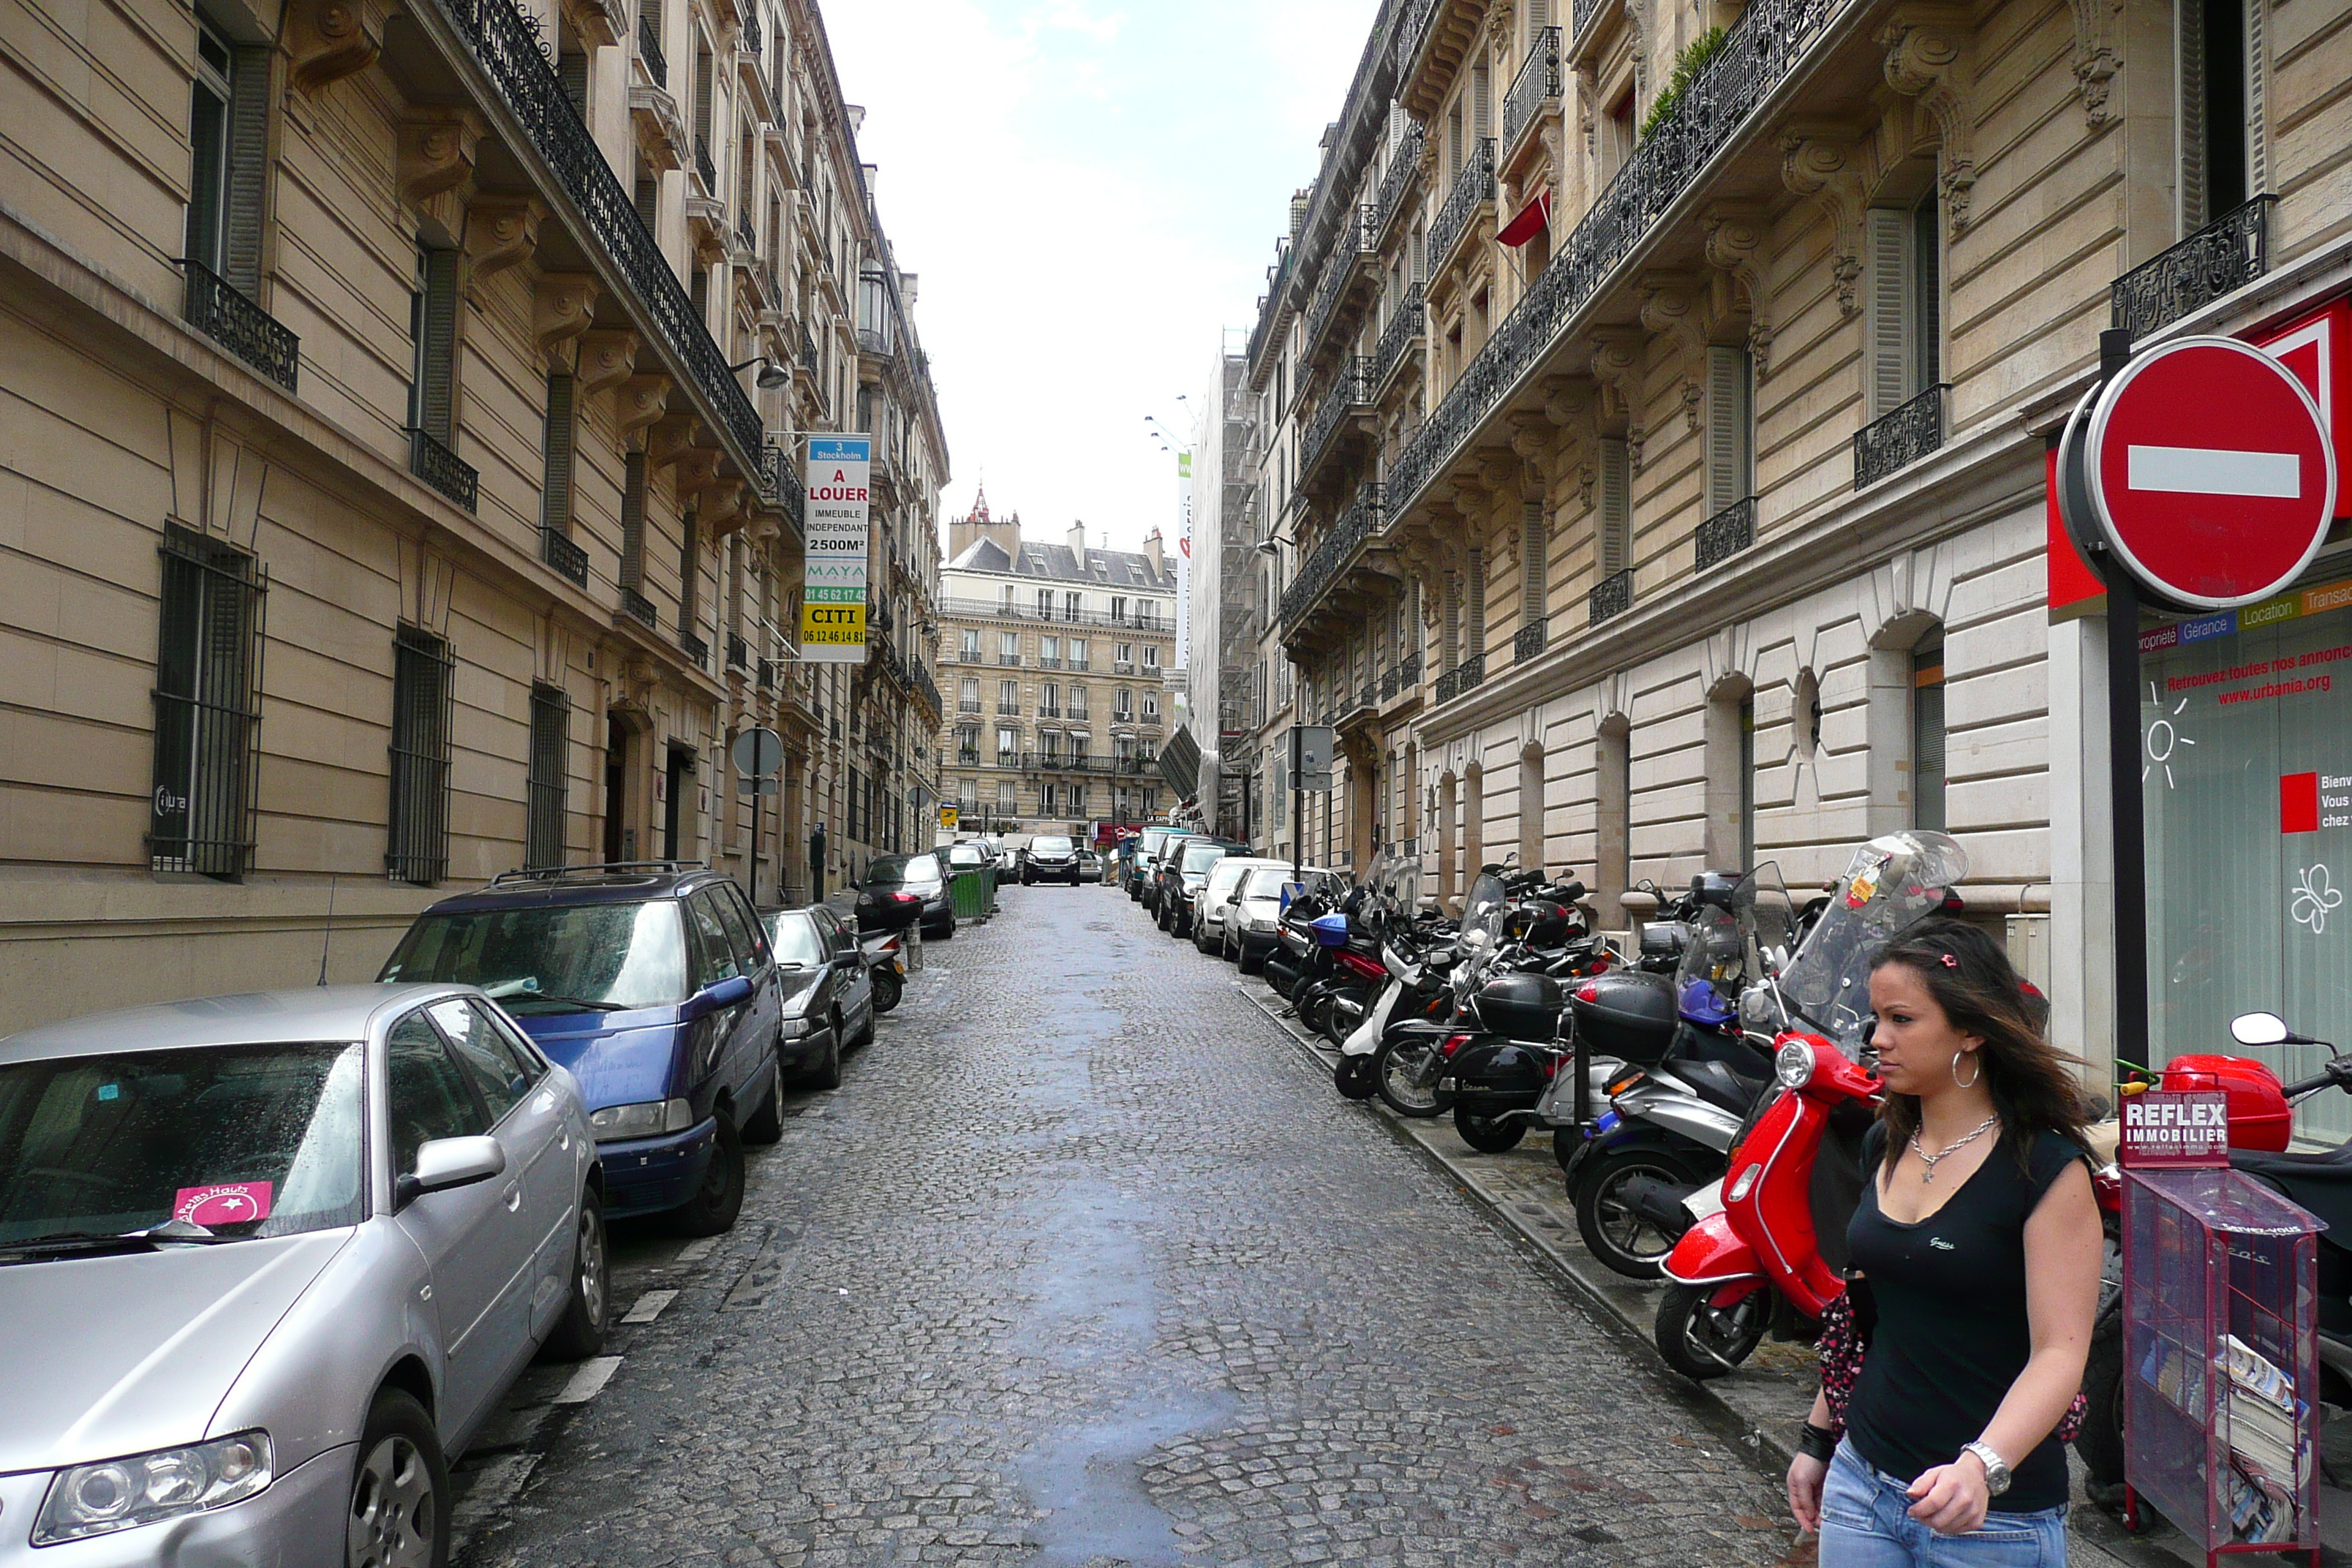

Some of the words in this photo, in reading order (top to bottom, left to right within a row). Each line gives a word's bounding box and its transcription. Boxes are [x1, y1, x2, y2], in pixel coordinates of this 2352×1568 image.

[836, 442, 843, 451] 3
[818, 451, 861, 459] Stockholm
[833, 470, 845, 483] A
[810, 487, 868, 501] LOUER
[815, 509, 861, 519] IMMEUBLE
[807, 523, 868, 532] INDEPENDANT
[807, 565, 864, 576] MAYA
[805, 589, 815, 600] 01
[818, 589, 829, 600] 45
[831, 589, 841, 600] 62
[844, 590, 854, 600] 17
[856, 590, 866, 600] 42
[811, 609, 856, 623] CITI
[2184, 618, 2227, 640] Gérance
[2244, 601, 2292, 625] Location
[804, 630, 814, 641] 06
[817, 630, 826, 641] 12
[829, 631, 839, 641] 46
[842, 631, 851, 642] 14
[853, 631, 863, 642] 81
[2168, 669, 2226, 692] Retrouvez
[2229, 661, 2269, 680] toutes
[2272, 656, 2296, 672] nos
[2299, 645, 2352, 667] annonc
[2219, 675, 2331, 705] www.urbania.org
[2321, 775, 2352, 789] Bienv
[2321, 795, 2349, 808] Vous
[2323, 814, 2349, 827] chez
[2126, 1104, 2225, 1126] REFLEX
[2126, 1128, 2225, 1142] IMMOBILIER
[209, 1185, 249, 1196] Hauts
